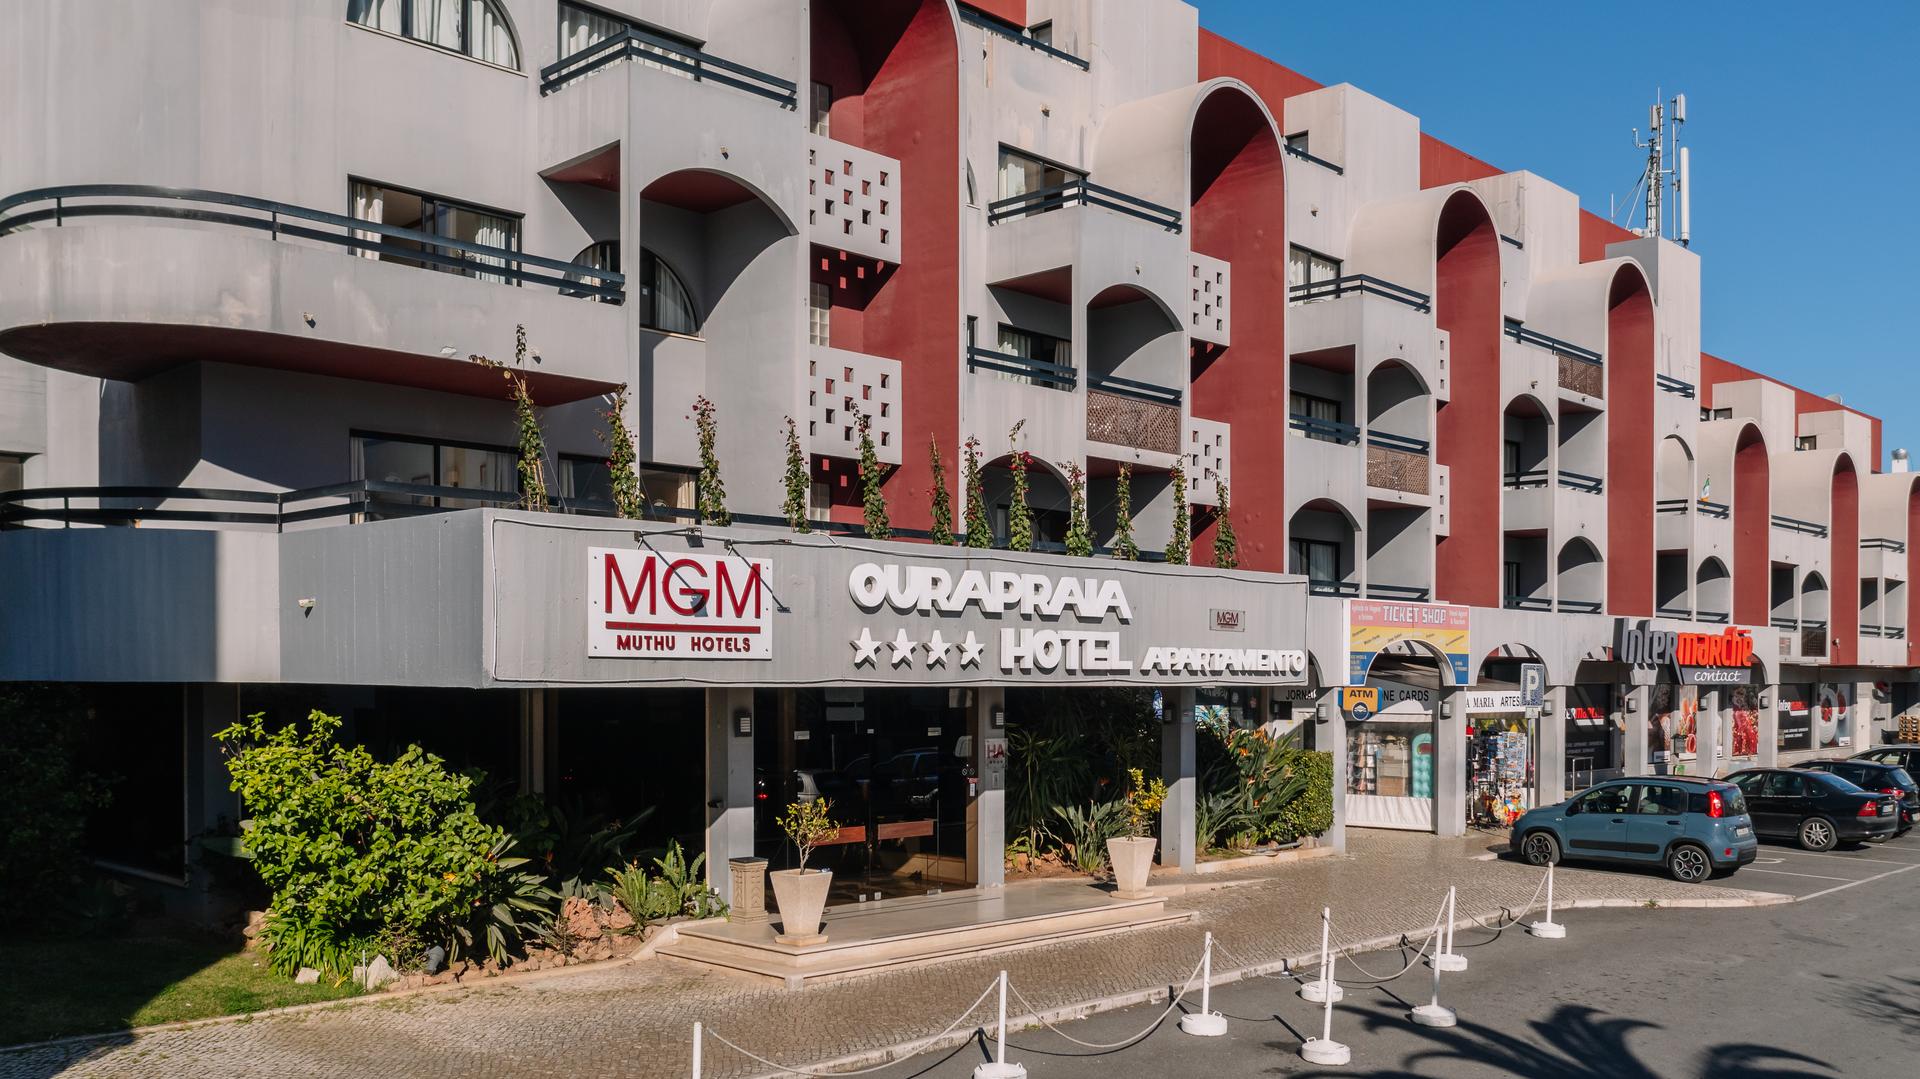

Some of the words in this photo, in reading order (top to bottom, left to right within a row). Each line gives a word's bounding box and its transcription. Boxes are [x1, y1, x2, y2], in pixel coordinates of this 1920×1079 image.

[605, 553, 761, 619] MGM
[849, 562, 1133, 621] OURAPRAIA
[1216, 611, 1239, 623] MGM
[1383, 605, 1420, 623] TICKET
[1422, 608, 1447, 625] SHOP
[616, 635, 676, 650] MUTHU
[690, 637, 751, 653] HOTELS
[1000, 627, 1133, 674] HOTEL
[1141, 646, 1306, 675] APARTAMENTO
[1694, 669, 1742, 682] contact
[1349, 690, 1373, 698] ATM
[1527, 669, 1539, 701] P
[1399, 690, 1429, 701] CARDS
[1473, 697, 1495, 707] MARIA
[1501, 696, 1520, 707] ARTES
